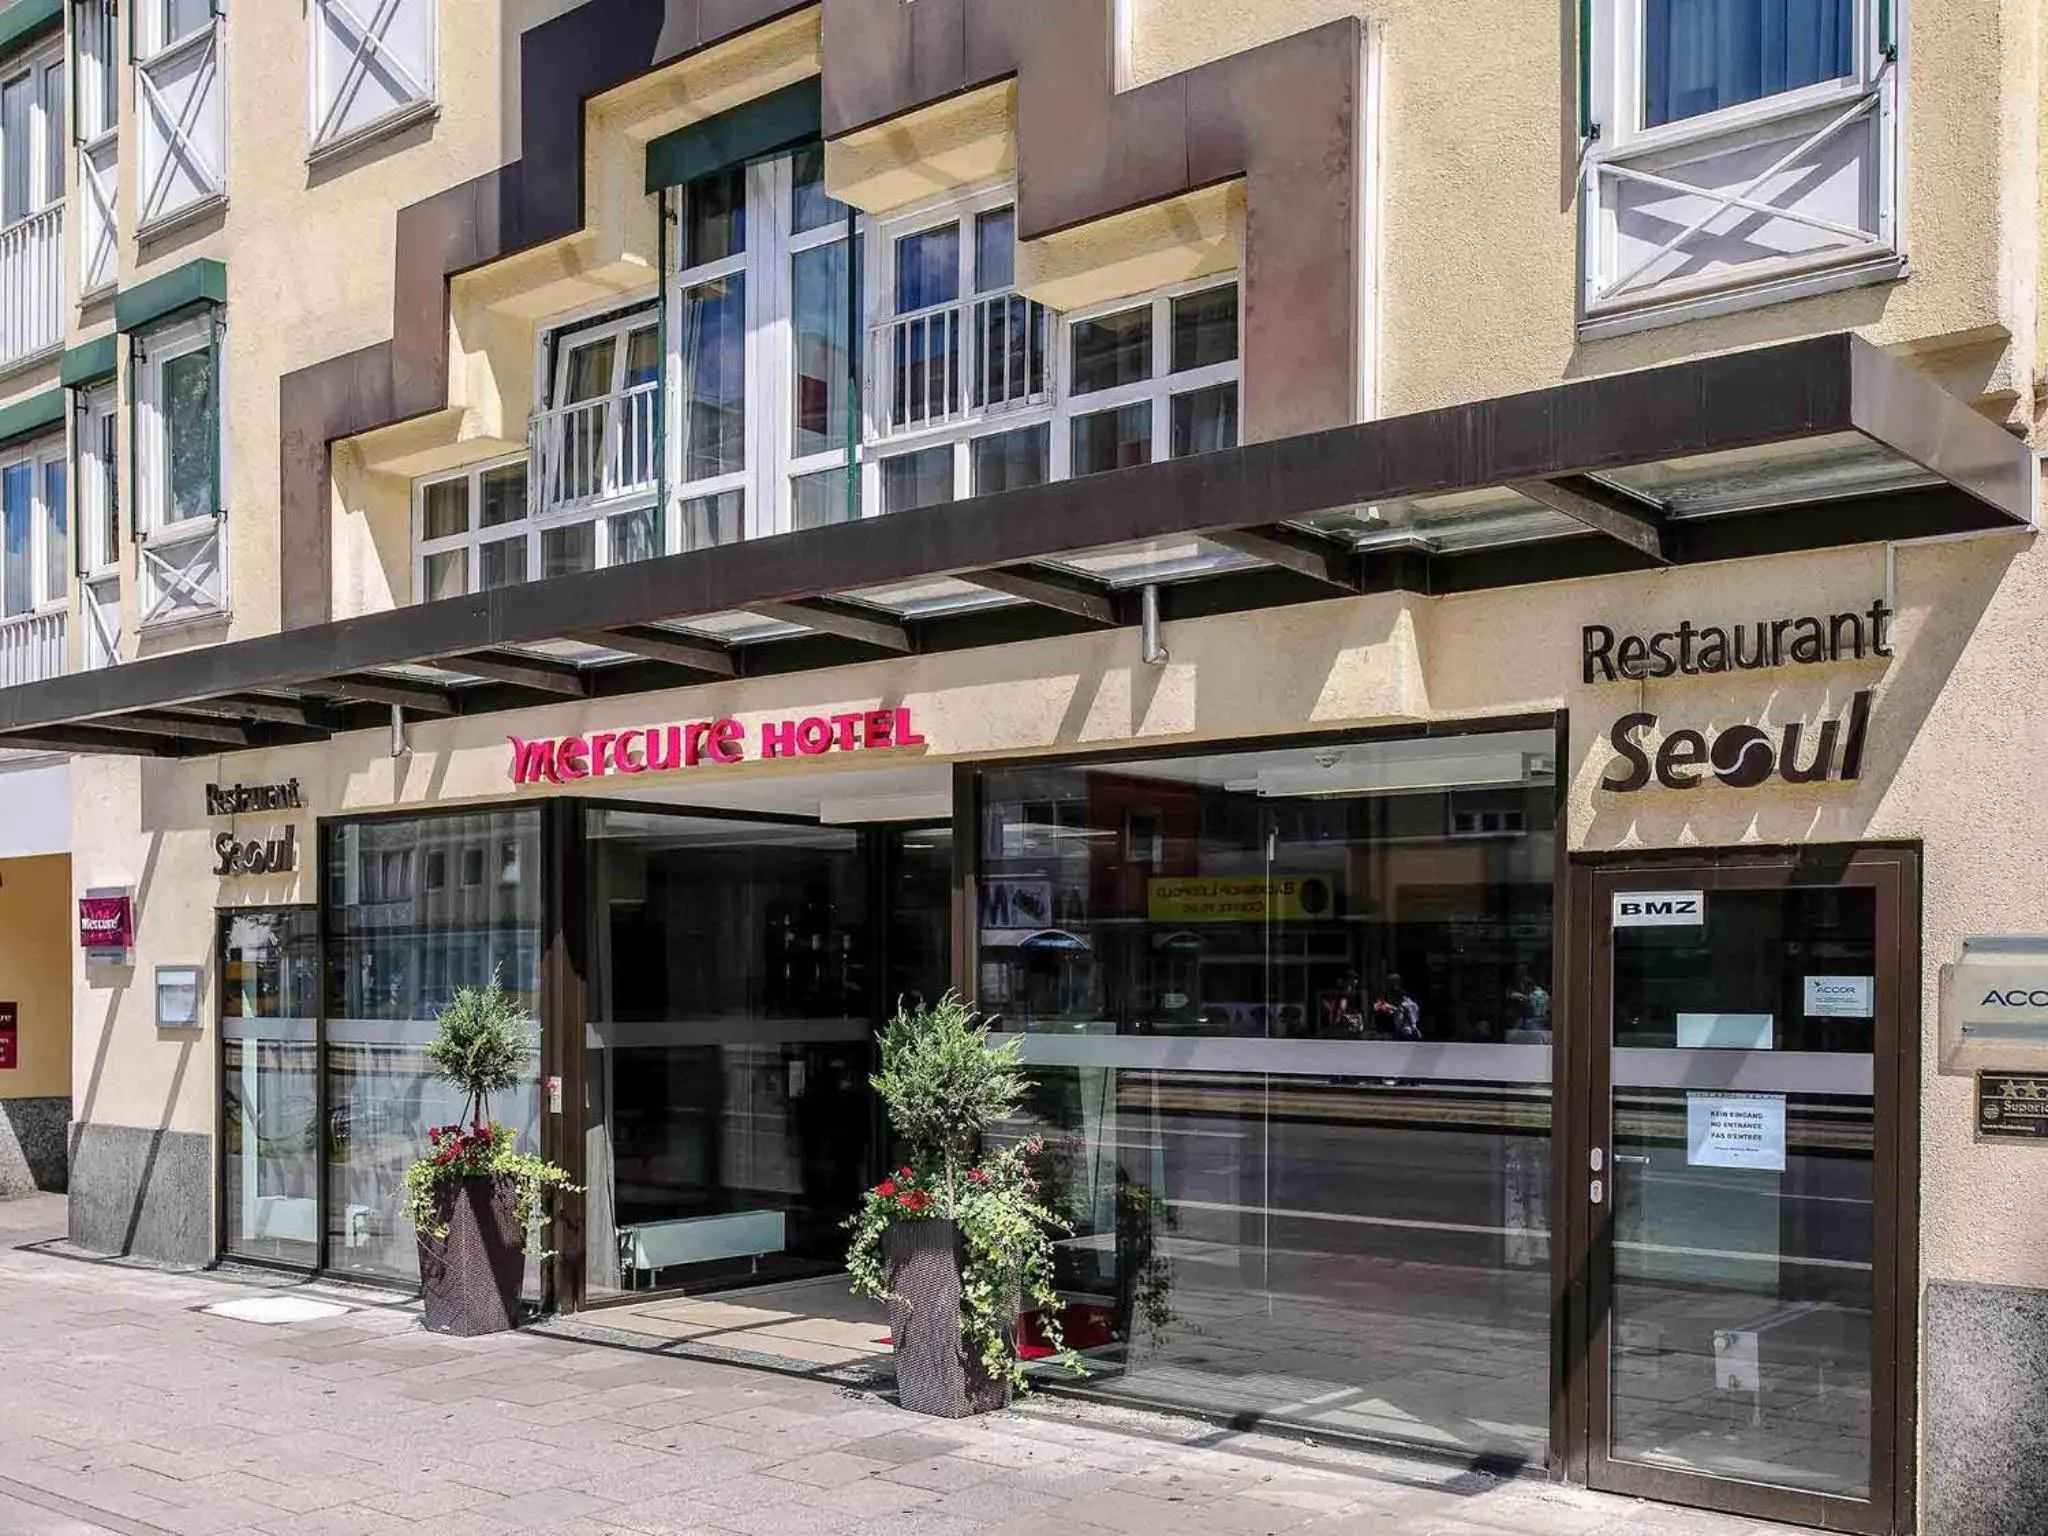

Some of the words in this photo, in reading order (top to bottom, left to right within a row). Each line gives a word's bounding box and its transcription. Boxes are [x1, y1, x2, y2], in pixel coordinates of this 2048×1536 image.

[1583, 599, 1894, 683] Restaurant
[761, 707, 926, 759] HOTEL
[1601, 690, 1872, 793] Seoul
[206, 777, 302, 816] Restaurant
[213, 824, 296, 876] Seoul
[1620, 901, 1697, 915] BMZ
[1816, 986, 1856, 994] ACCOR
[1711, 1132, 1725, 1140] PAS
[1723, 1122, 1763, 1130] ENTRANCE
